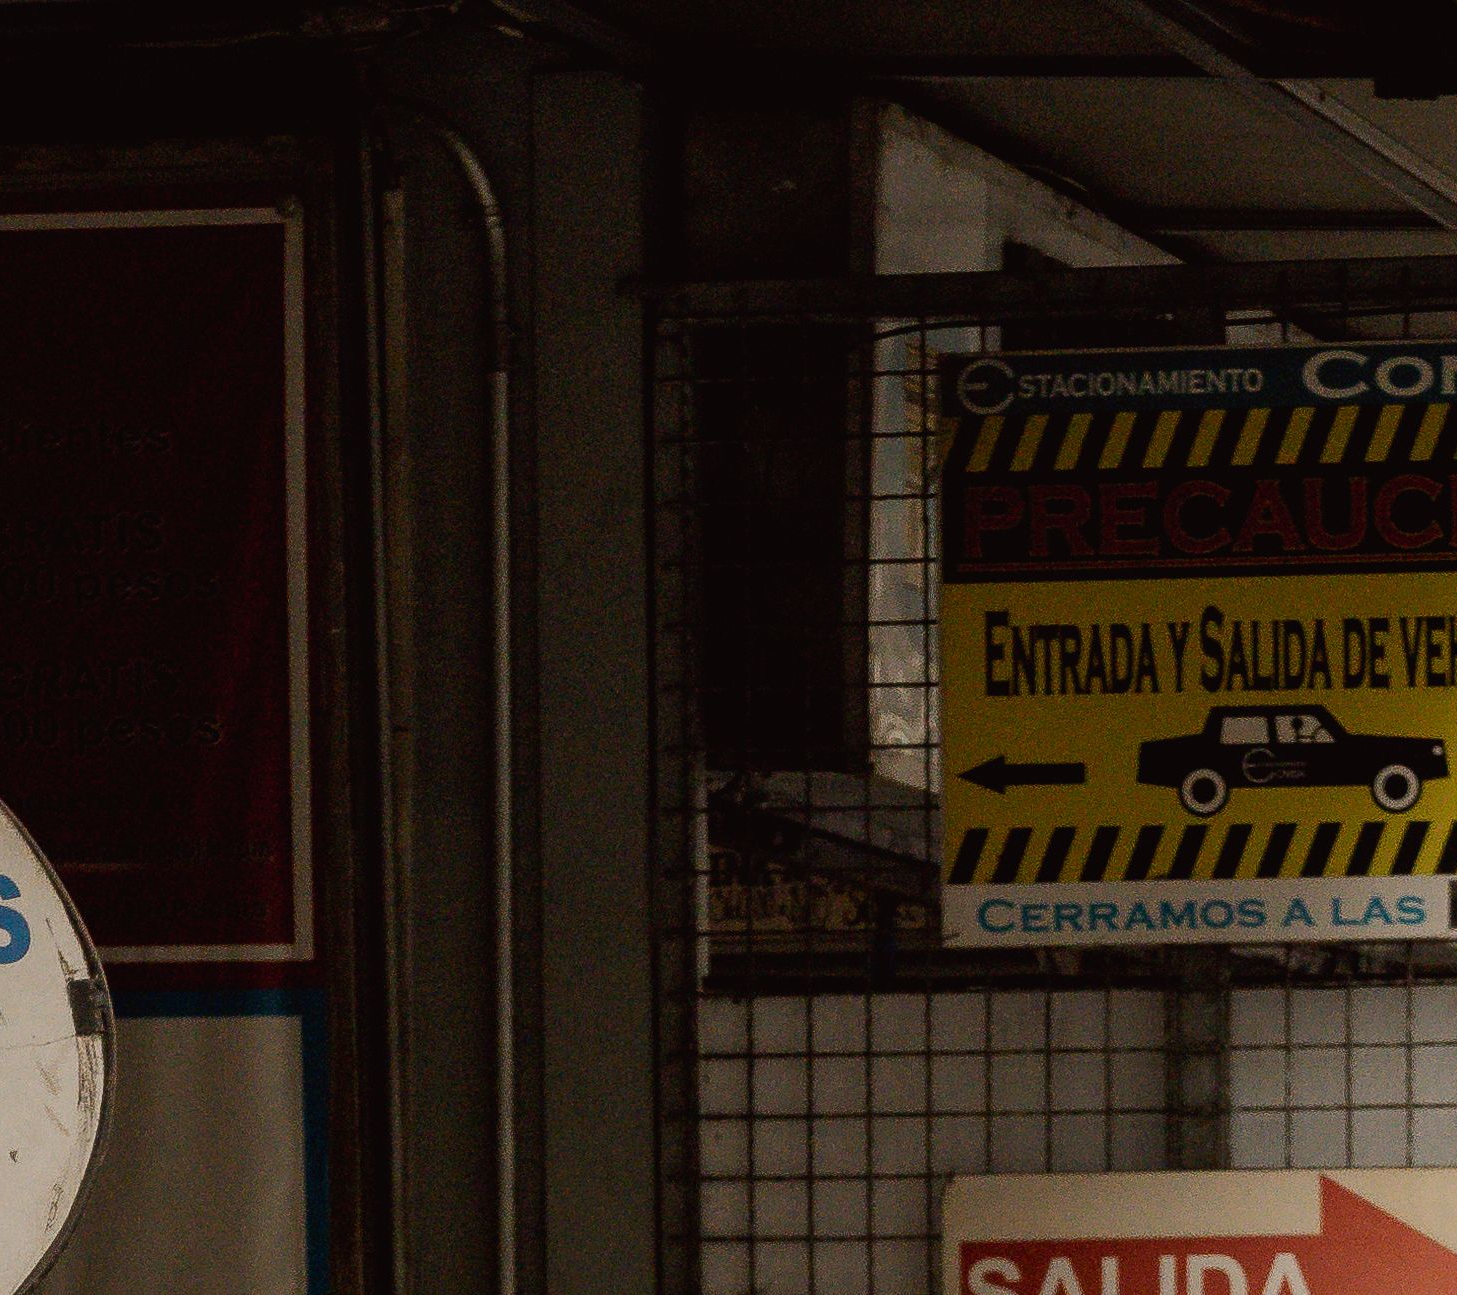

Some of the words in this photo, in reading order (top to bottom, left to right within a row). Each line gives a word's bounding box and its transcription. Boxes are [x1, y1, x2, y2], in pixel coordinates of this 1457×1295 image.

[984, 609, 1161, 697] ENTRADA
[1167, 618, 1198, 692] Y
[1199, 604, 1333, 694] SALIDA
[1342, 616, 1388, 689] DE
[977, 896, 1268, 935] CERRAMOS
[1279, 898, 1315, 928] A
[1330, 895, 1427, 927] LAS
